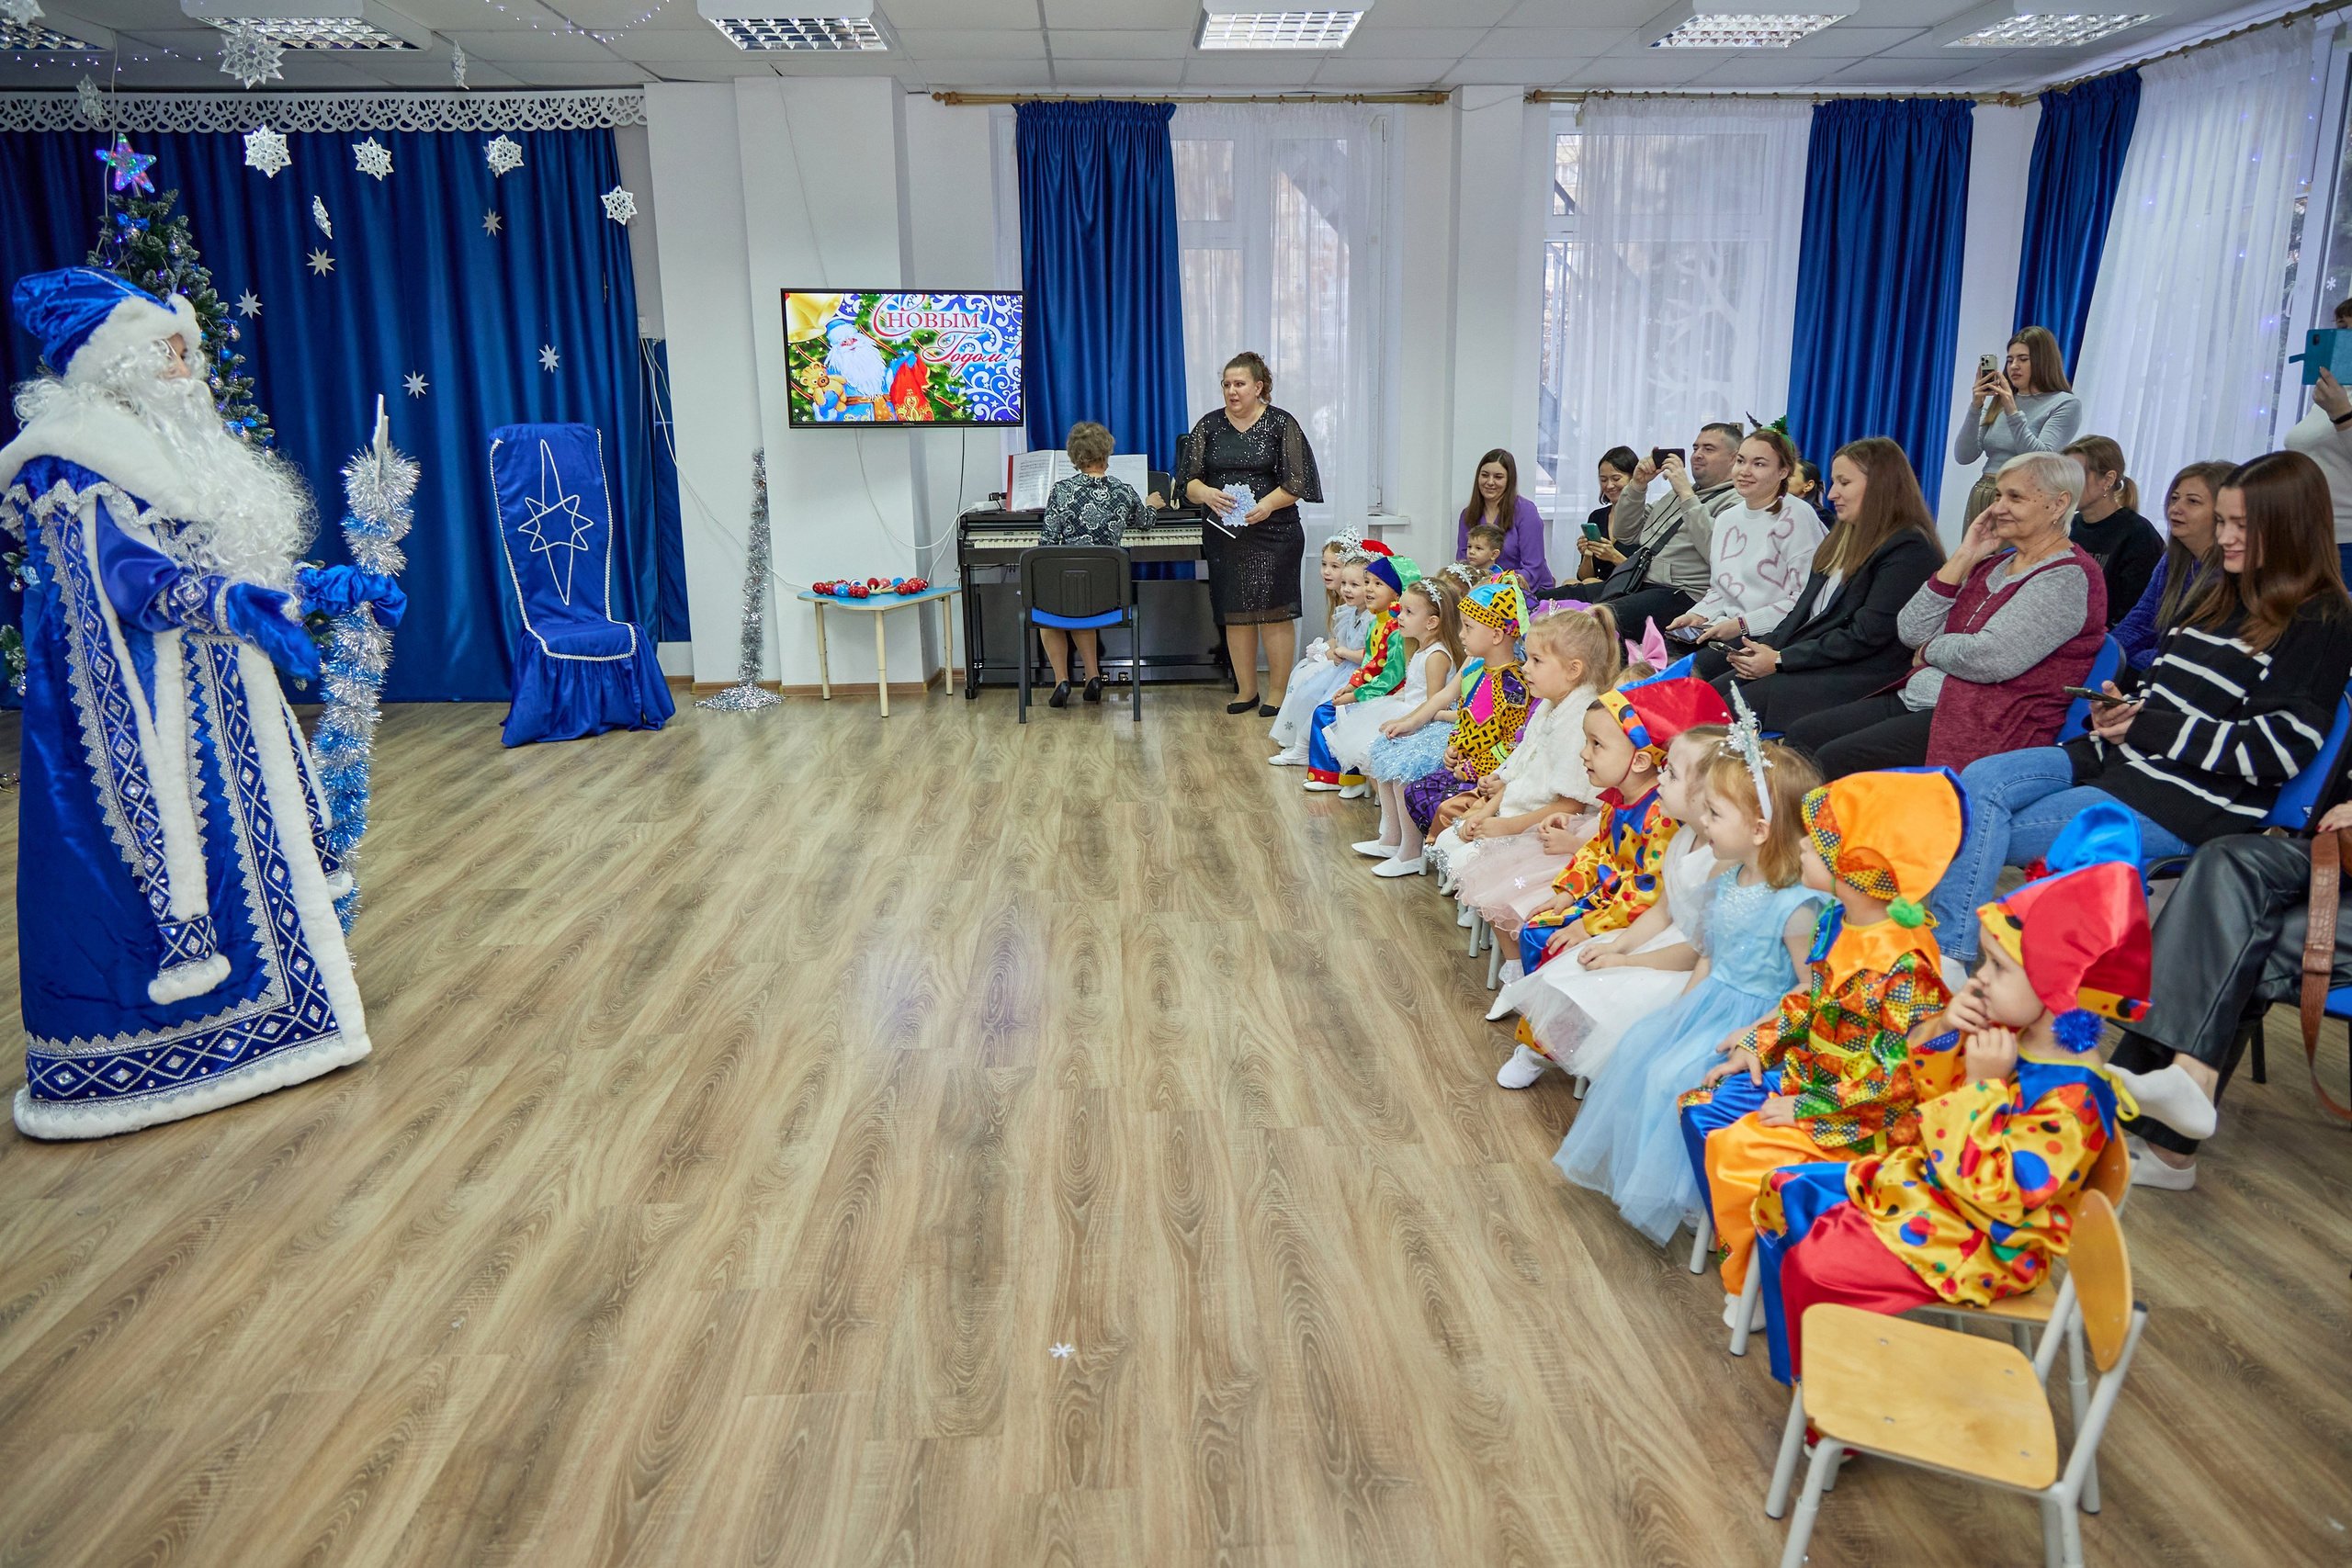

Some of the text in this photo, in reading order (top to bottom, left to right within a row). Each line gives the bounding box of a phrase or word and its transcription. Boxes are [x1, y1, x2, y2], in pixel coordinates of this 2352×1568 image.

[873, 294, 979, 337] С НОВЫМ
[922, 331, 1022, 378] Годом!
